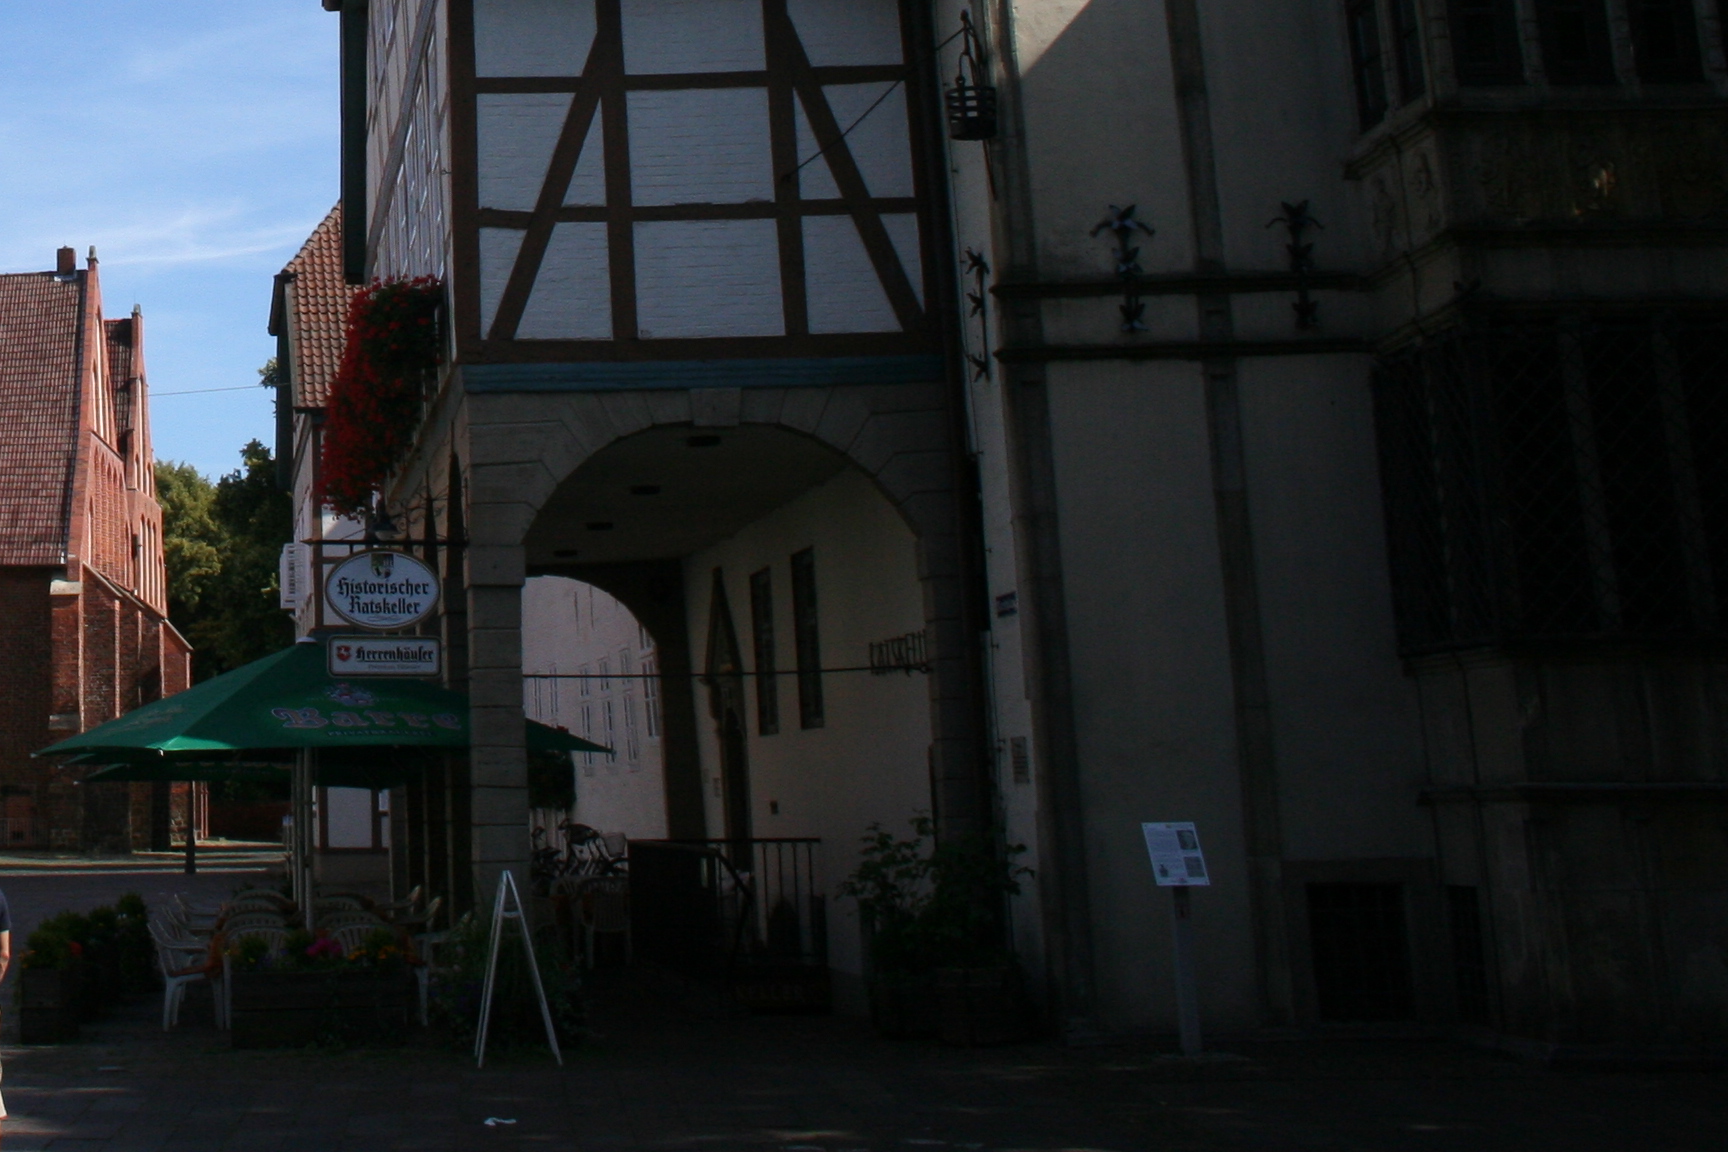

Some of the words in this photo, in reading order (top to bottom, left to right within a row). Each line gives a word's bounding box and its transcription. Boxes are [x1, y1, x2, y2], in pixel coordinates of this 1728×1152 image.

[336, 576, 430, 599] Historischer
[348, 595, 421, 616] Ratskeller
[271, 706, 462, 730] Barre
